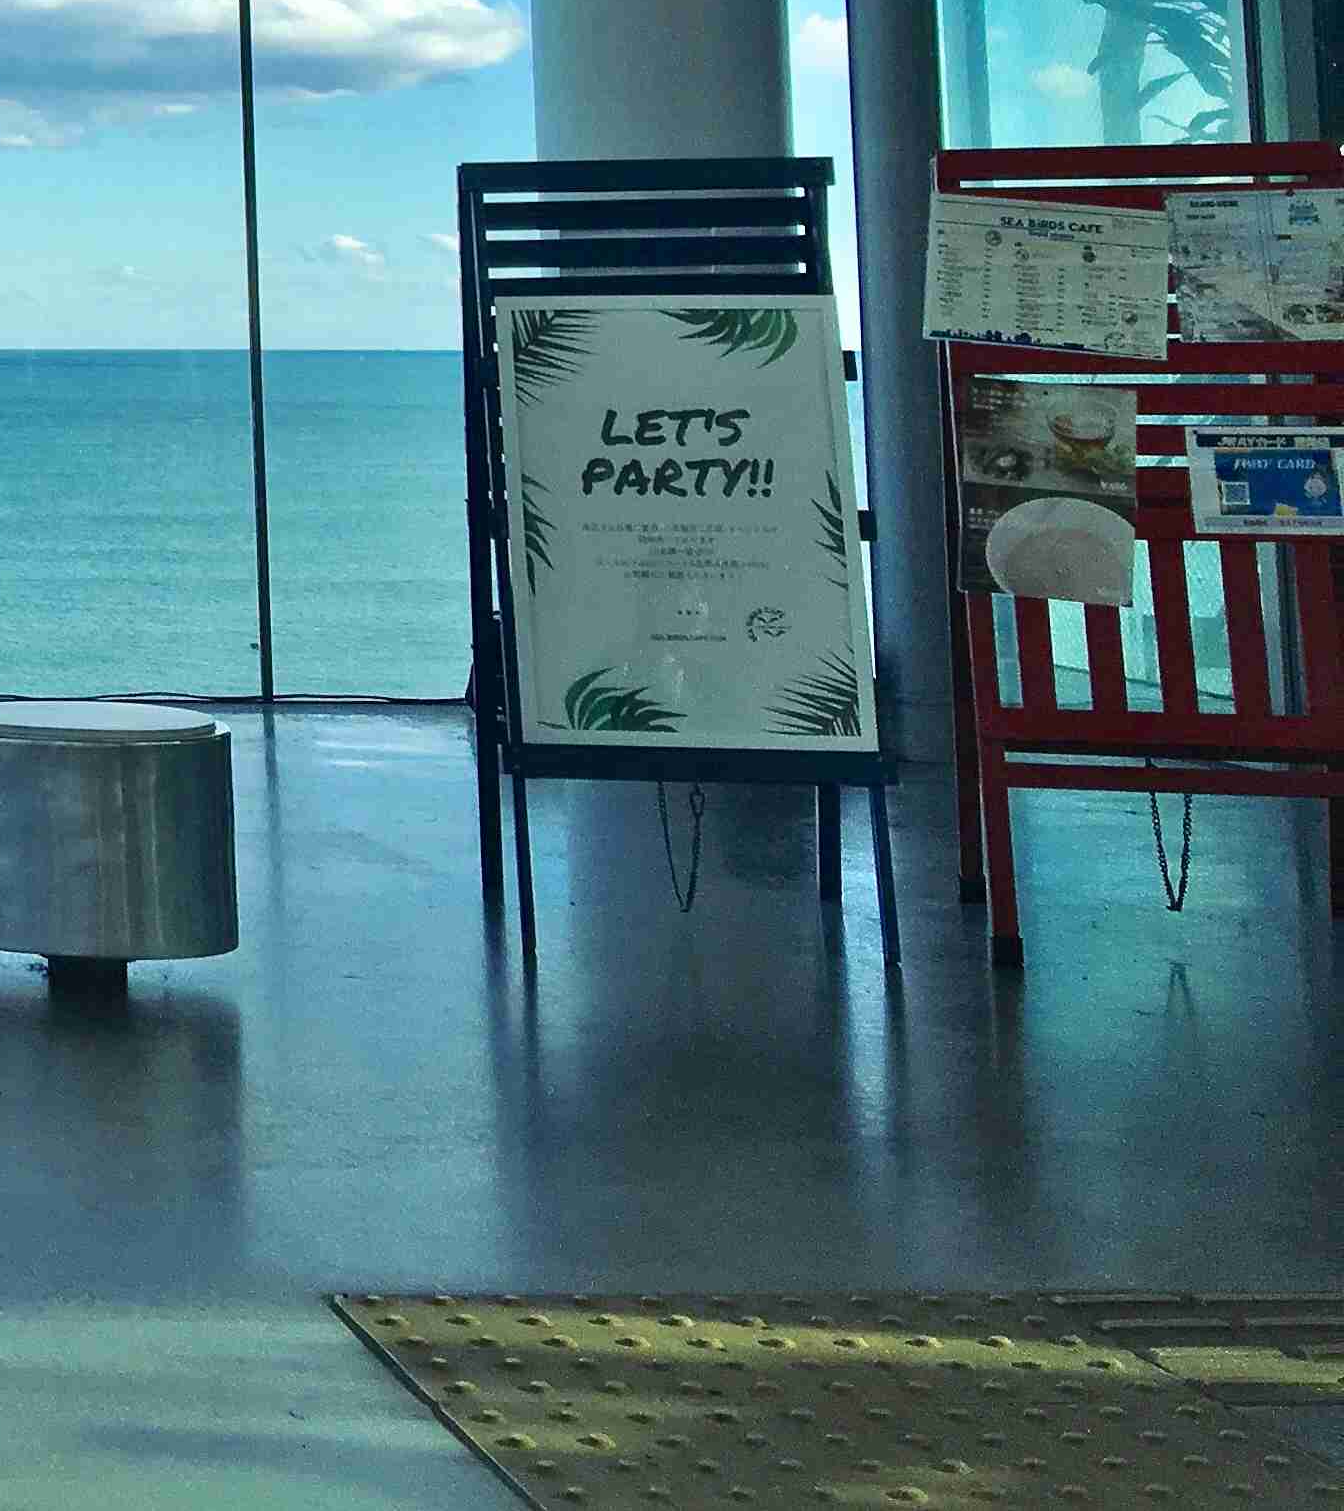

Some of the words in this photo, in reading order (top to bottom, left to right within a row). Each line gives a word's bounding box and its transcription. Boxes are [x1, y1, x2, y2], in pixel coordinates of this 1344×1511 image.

[1000, 216, 1024, 227] SEA
[600, 408, 751, 446] LET'S
[582, 457, 774, 497] PARTY!!
